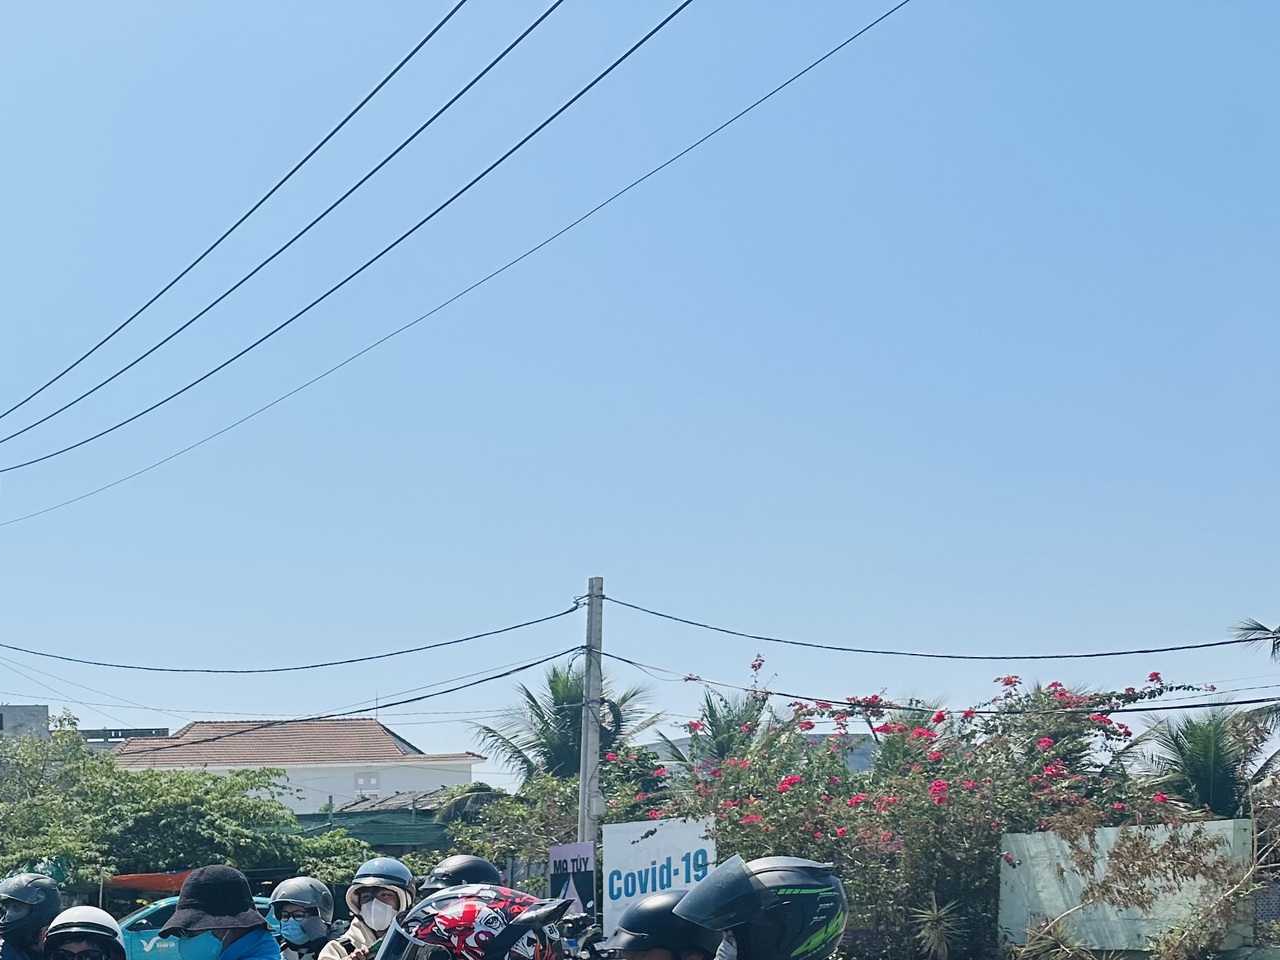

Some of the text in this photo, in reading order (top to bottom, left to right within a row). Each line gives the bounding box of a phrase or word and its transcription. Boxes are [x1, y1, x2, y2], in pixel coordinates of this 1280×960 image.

[553, 854, 589, 874] MA TÚY
[608, 848, 708, 901] Covid-19
